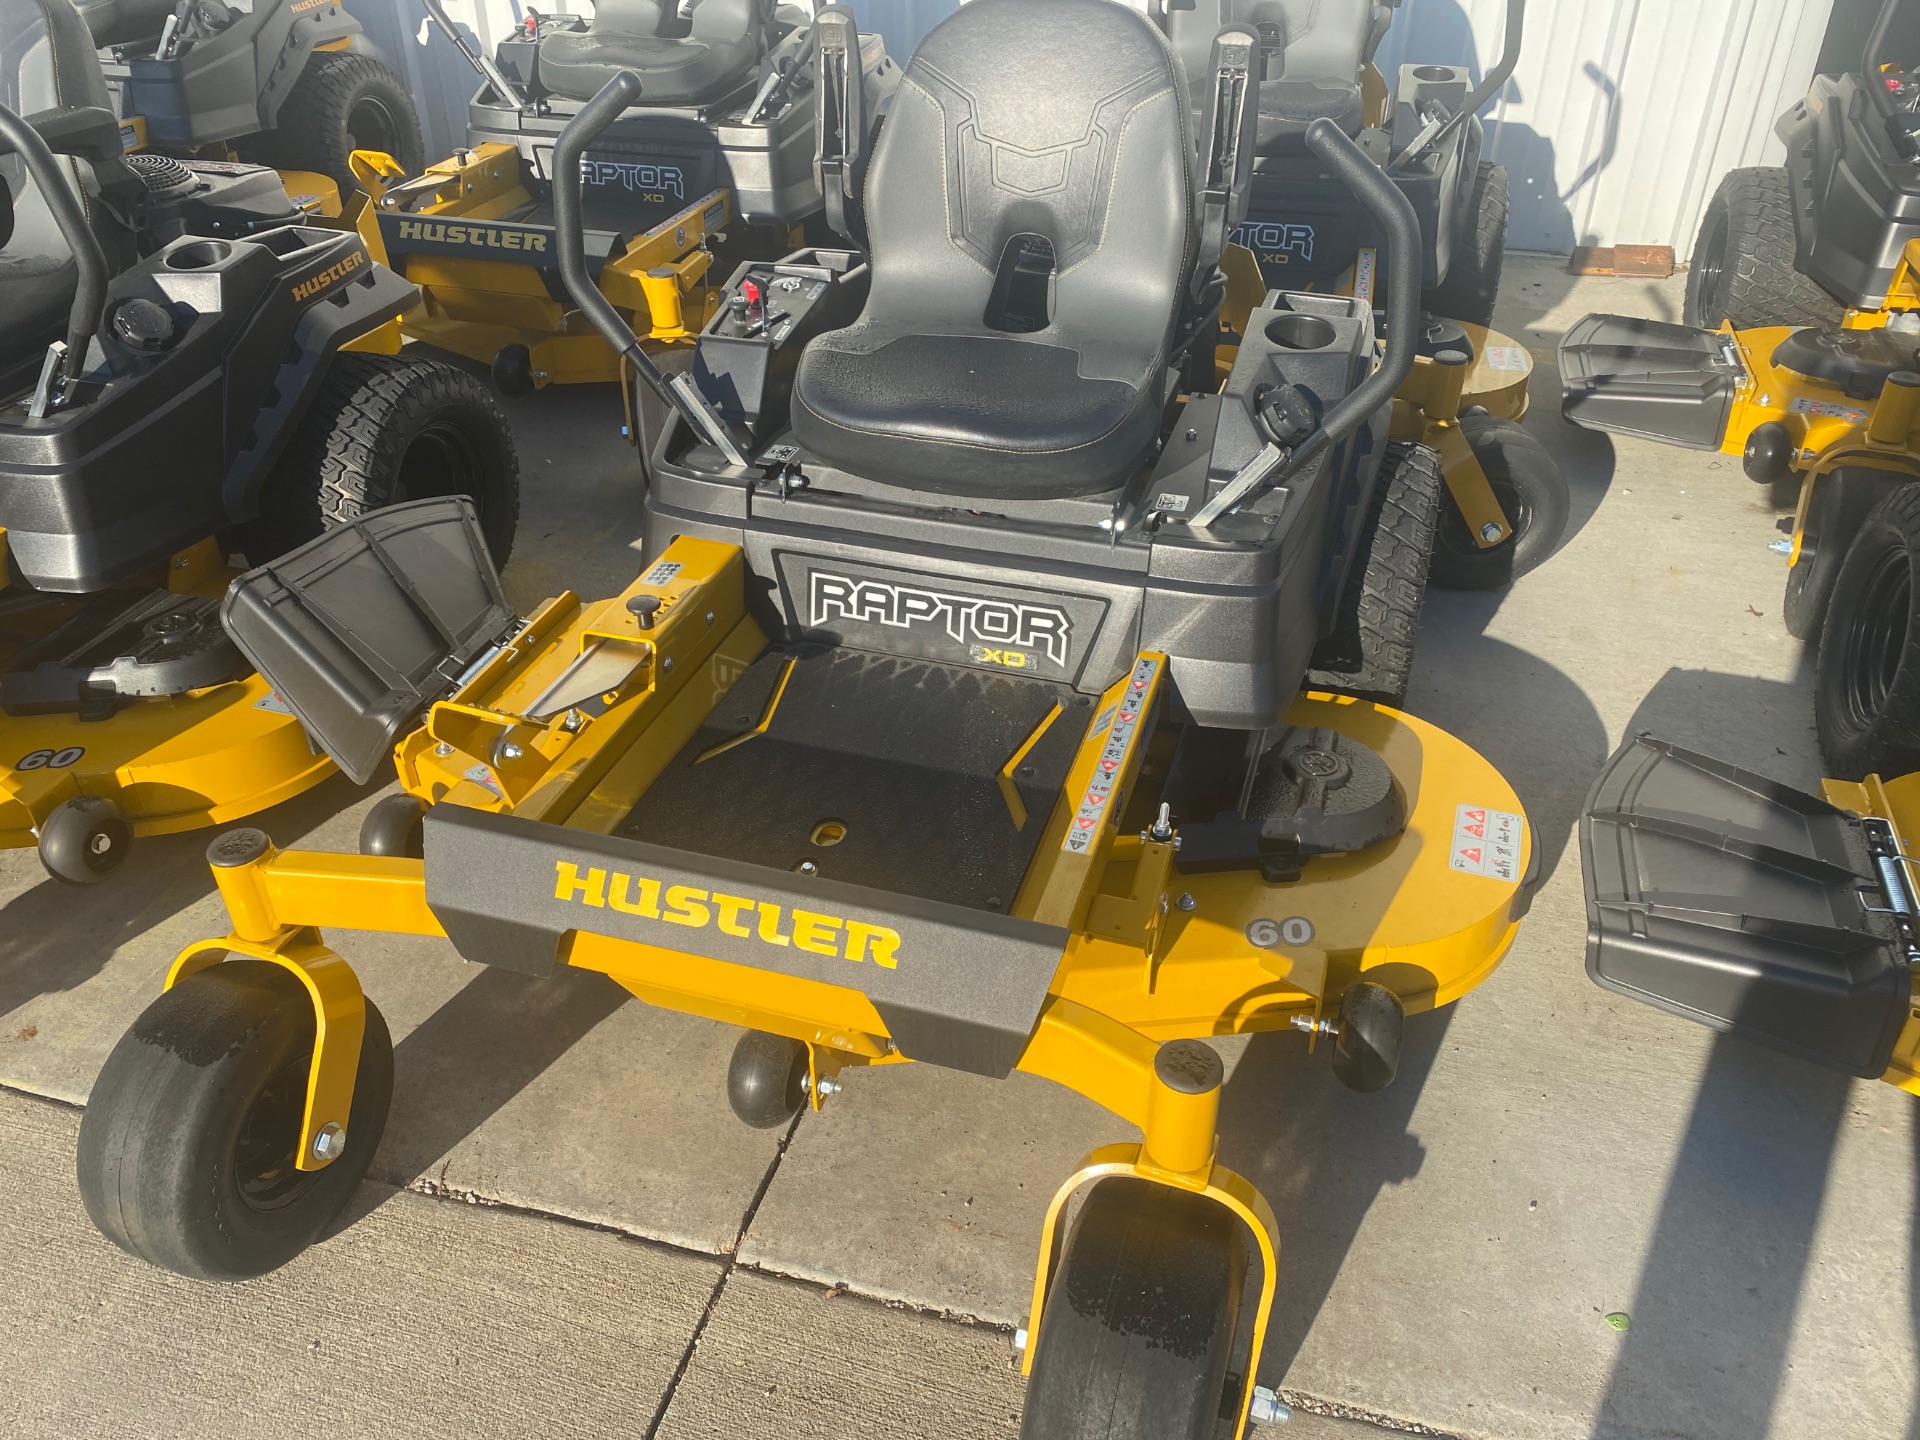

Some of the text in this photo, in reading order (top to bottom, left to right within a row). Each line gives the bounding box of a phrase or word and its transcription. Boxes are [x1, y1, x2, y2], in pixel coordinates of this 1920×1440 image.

[290, 0, 329, 14] HUSTL
[580, 159, 684, 200] APTOR
[643, 193, 665, 203] XD
[400, 221, 547, 252] HUSTLER
[1262, 253, 1289, 264] XD
[291, 250, 364, 302] HUSTLER
[810, 572, 1070, 668] RAPTOR
[982, 647, 1026, 668] XD
[17, 747, 84, 770] 60
[554, 860, 901, 970] HUSTLER
[1248, 917, 1313, 948] 60
